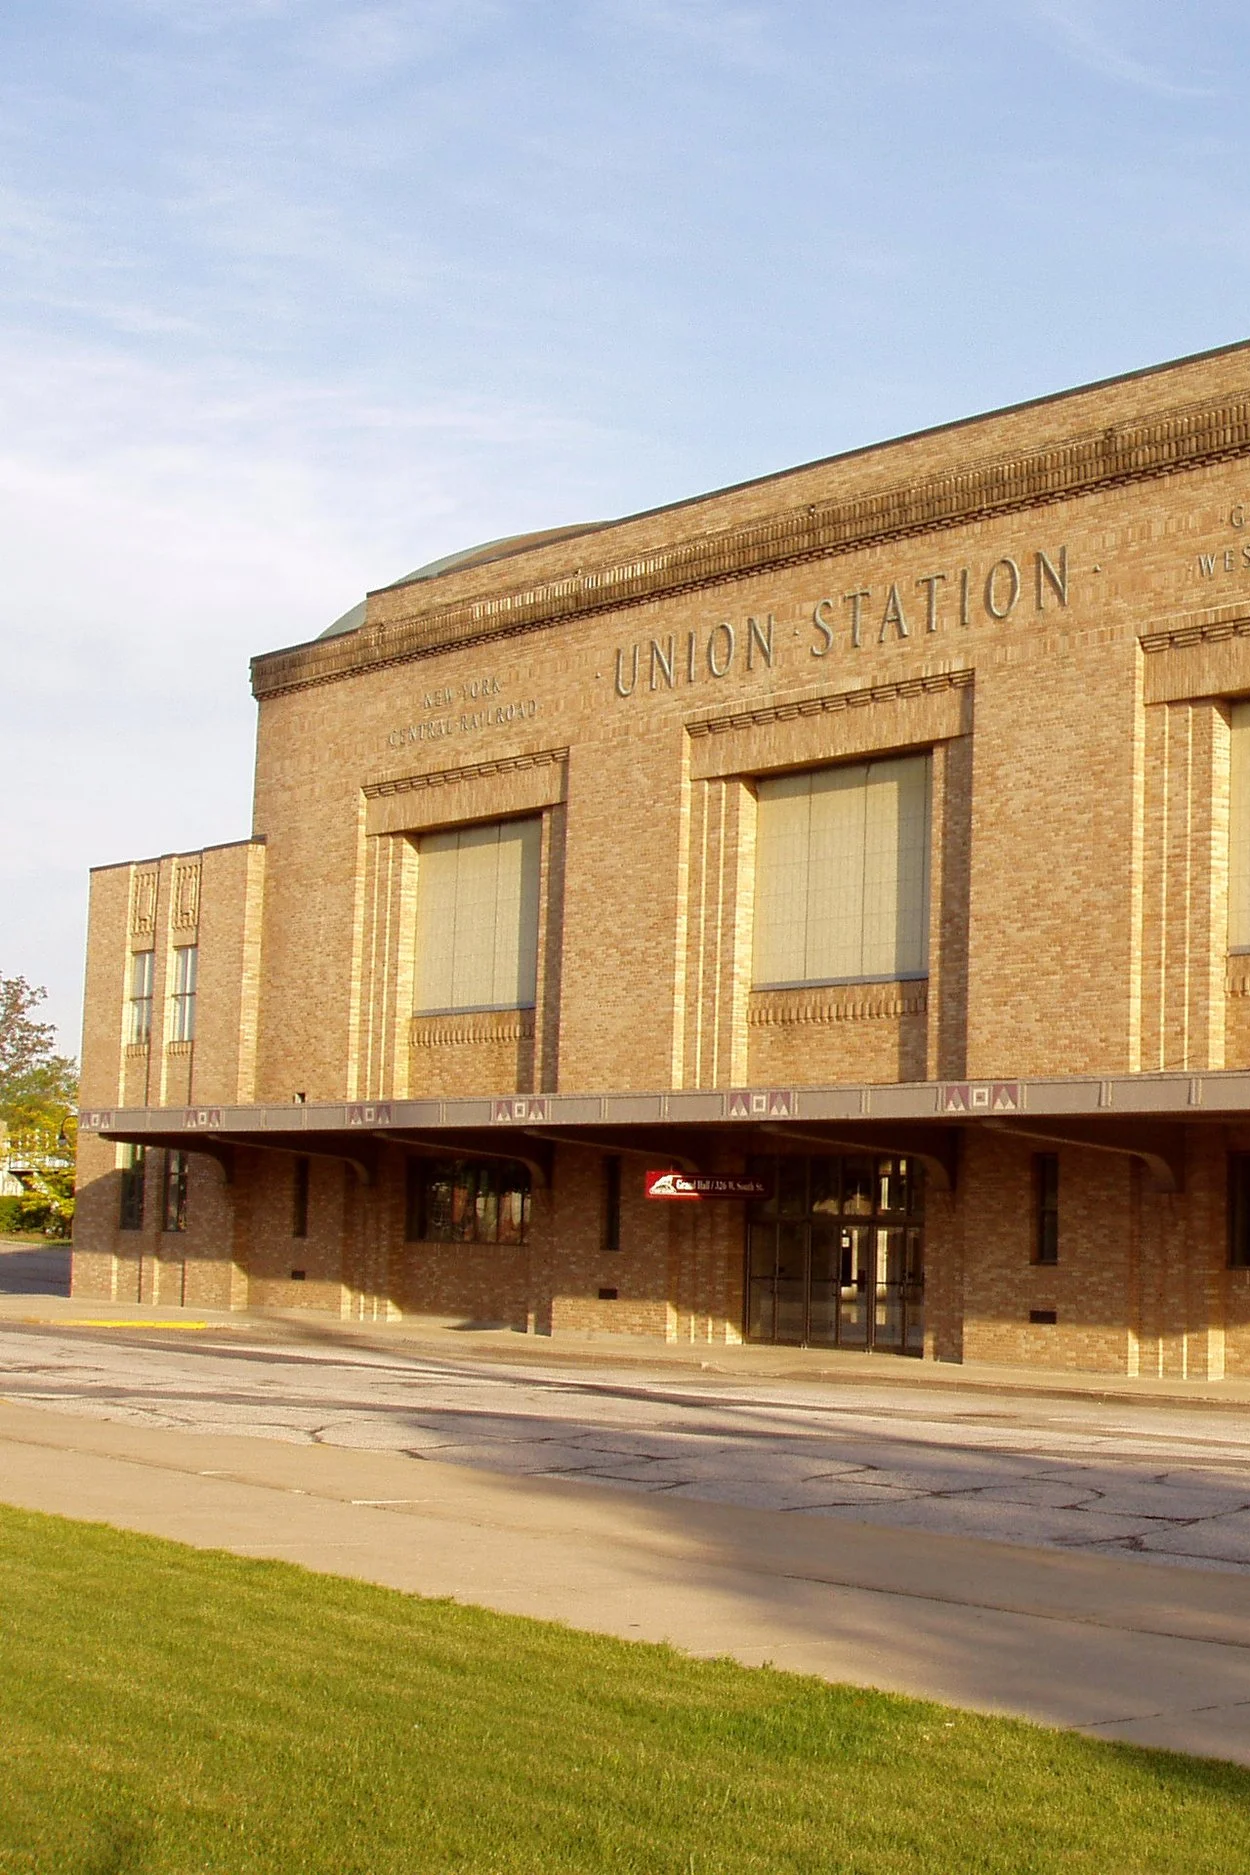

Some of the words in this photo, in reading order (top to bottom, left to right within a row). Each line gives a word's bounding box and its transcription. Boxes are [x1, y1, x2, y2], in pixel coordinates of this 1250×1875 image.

[615, 613, 775, 697] UNION
[810, 545, 1069, 657] STATION
[423, 687, 453, 710] NEW
[462, 676, 501, 700] YORK
[387, 717, 453, 747] CENTRAL
[458, 699, 537, 732] RAILROAD
